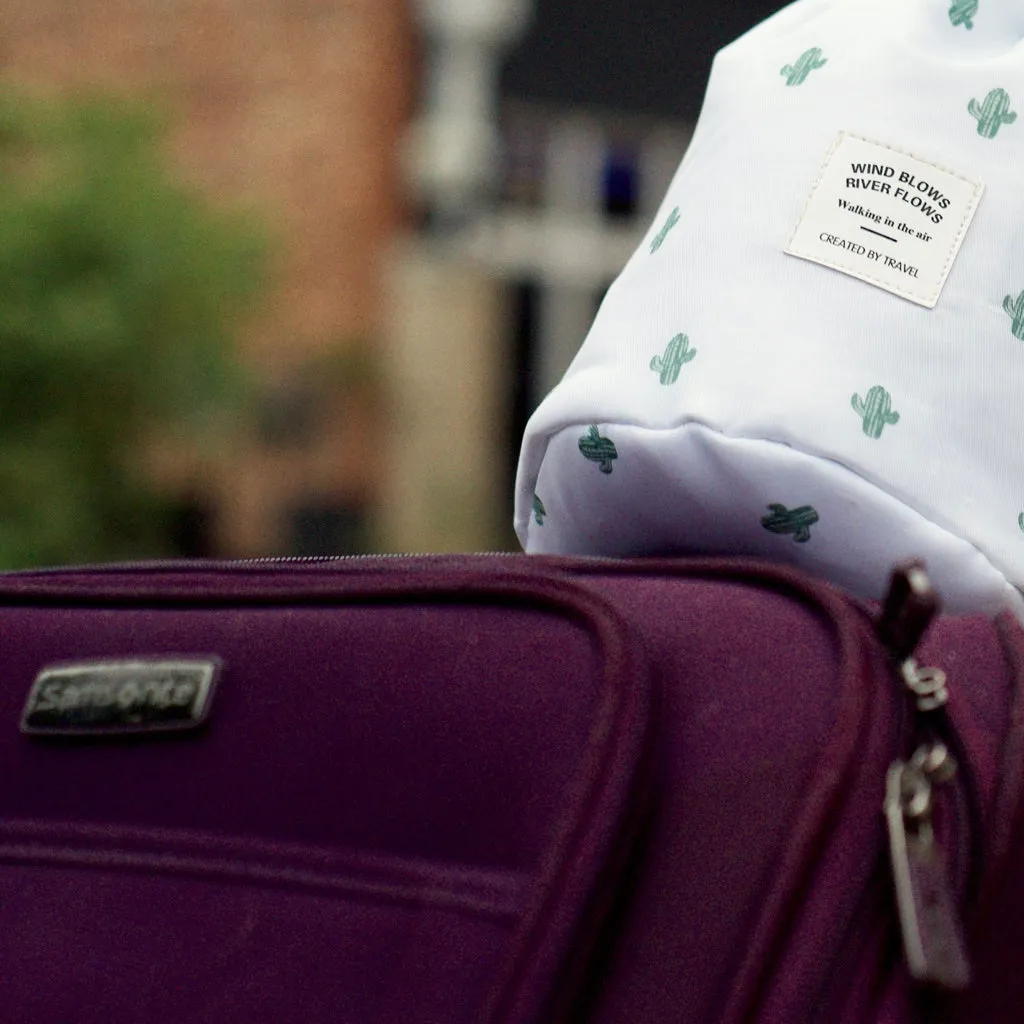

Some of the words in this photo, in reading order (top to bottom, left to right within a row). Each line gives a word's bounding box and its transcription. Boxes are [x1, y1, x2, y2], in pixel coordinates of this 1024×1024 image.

[846, 177, 892, 194] RIVER
[894, 187, 943, 224] FLOWS
[851, 163, 895, 178] WIND
[898, 171, 951, 209] BLOWS
[837, 198, 882, 223] Walking
[884, 216, 895, 228] in
[897, 223, 915, 235] the
[916, 231, 932, 243] air
[819, 232, 866, 256] CREATED
[867, 249, 882, 261] BY
[884, 256, 919, 278] TRAVEL
